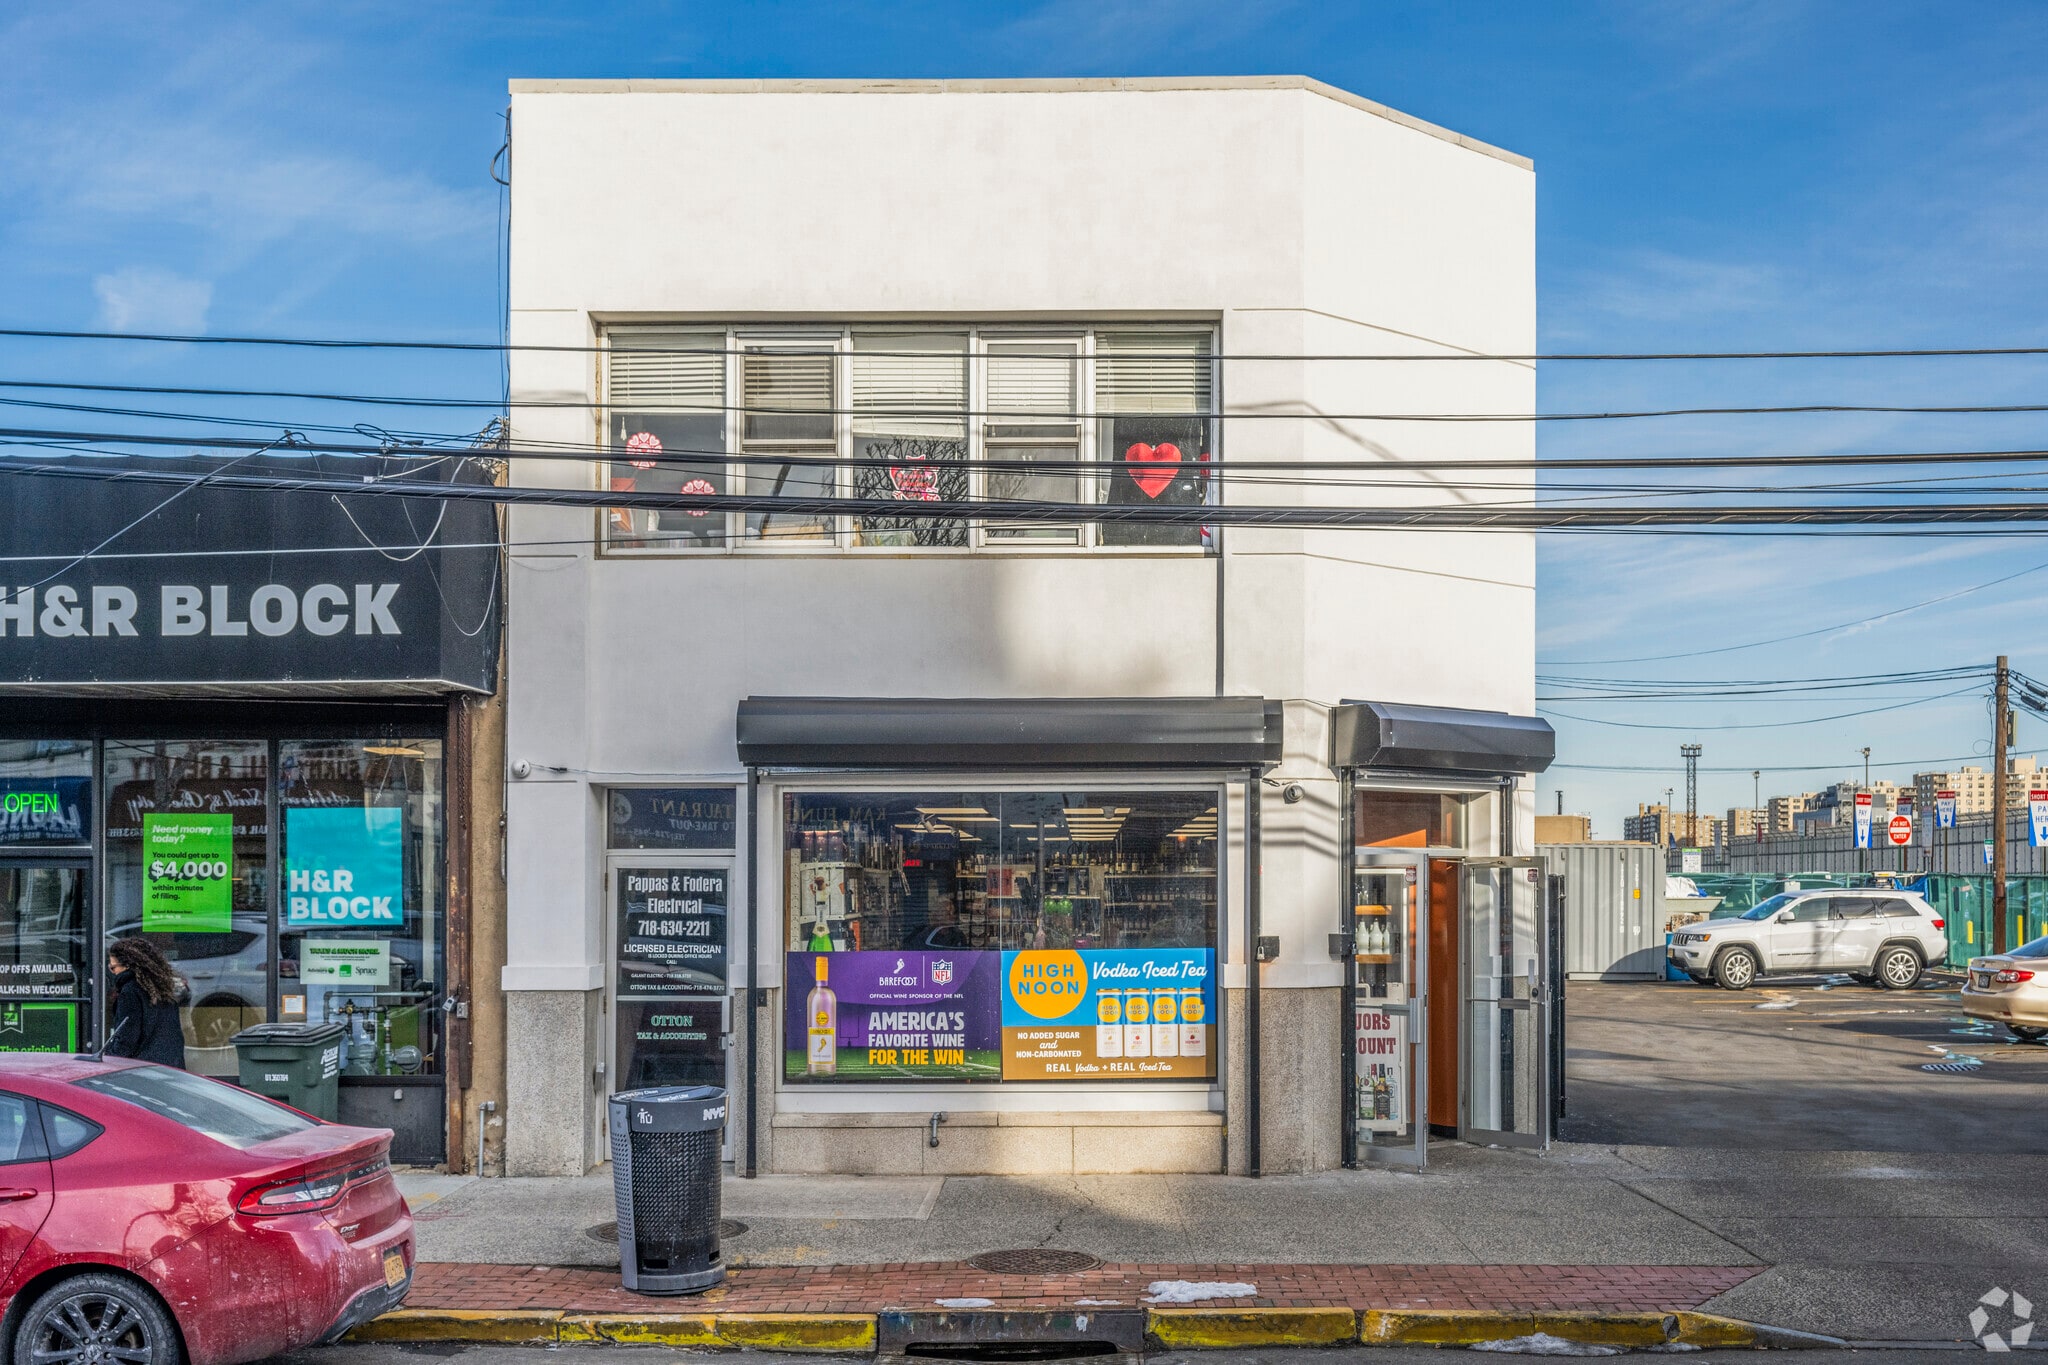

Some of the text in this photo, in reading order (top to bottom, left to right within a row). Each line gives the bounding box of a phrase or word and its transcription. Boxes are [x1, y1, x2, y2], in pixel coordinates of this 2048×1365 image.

[0, 583, 402, 637] H&R BLOCK
[4, 793, 58, 813] OPEN
[152, 824, 179, 834] Need
[180, 826, 213, 836] money
[151, 834, 186, 844] today?
[152, 851, 166, 859] You
[167, 851, 187, 859] could
[188, 851, 200, 860] get
[201, 852, 211, 860] up
[149, 859, 228, 881] $4,000
[290, 869, 354, 893] H&R
[627, 875, 723, 893] Pappas & Fodera
[152, 884, 204, 892] within minutes
[290, 896, 393, 920] BLOCK
[647, 897, 702, 914] Electrical
[638, 920, 710, 936] 718-634-2211
[624, 944, 721, 954] LICENSED ELECTRICIAN
[11, 964, 31, 974] OFFS
[31, 964, 73, 974] AVAILABLE
[355, 965, 378, 976] Spruce
[934, 969, 951, 981] NFL
[1023, 963, 1074, 978] HIGH
[1092, 959, 1208, 980] Vodka Iced Tea
[879, 976, 918, 986] BAREFOOT
[32, 985, 74, 995] WELCOME
[1018, 981, 1080, 996] NOON
[650, 1015, 694, 1027] OTTON
[868, 1011, 965, 1031] AMERICA'S
[636, 1032, 708, 1041] TAX & ACCOUNTING
[868, 1033, 965, 1048] FAVORITE WINE
[1017, 1032, 1028, 1040] NO
[1055, 1031, 1080, 1039] SUGAR
[1039, 1040, 1059, 1050] and
[1356, 1037, 1397, 1055] OUNT
[868, 1049, 965, 1065] FOR THE WIN
[1016, 1050, 1082, 1059] NON-CARBONATED
[1046, 1063, 1072, 1073] REAL
[1074, 1063, 1100, 1073] Vodka
[1110, 1062, 1136, 1072] REAL
[1139, 1061, 1158, 1072] Iced
[1158, 1061, 1173, 1071] Tea
[702, 1106, 725, 1121] NYC
